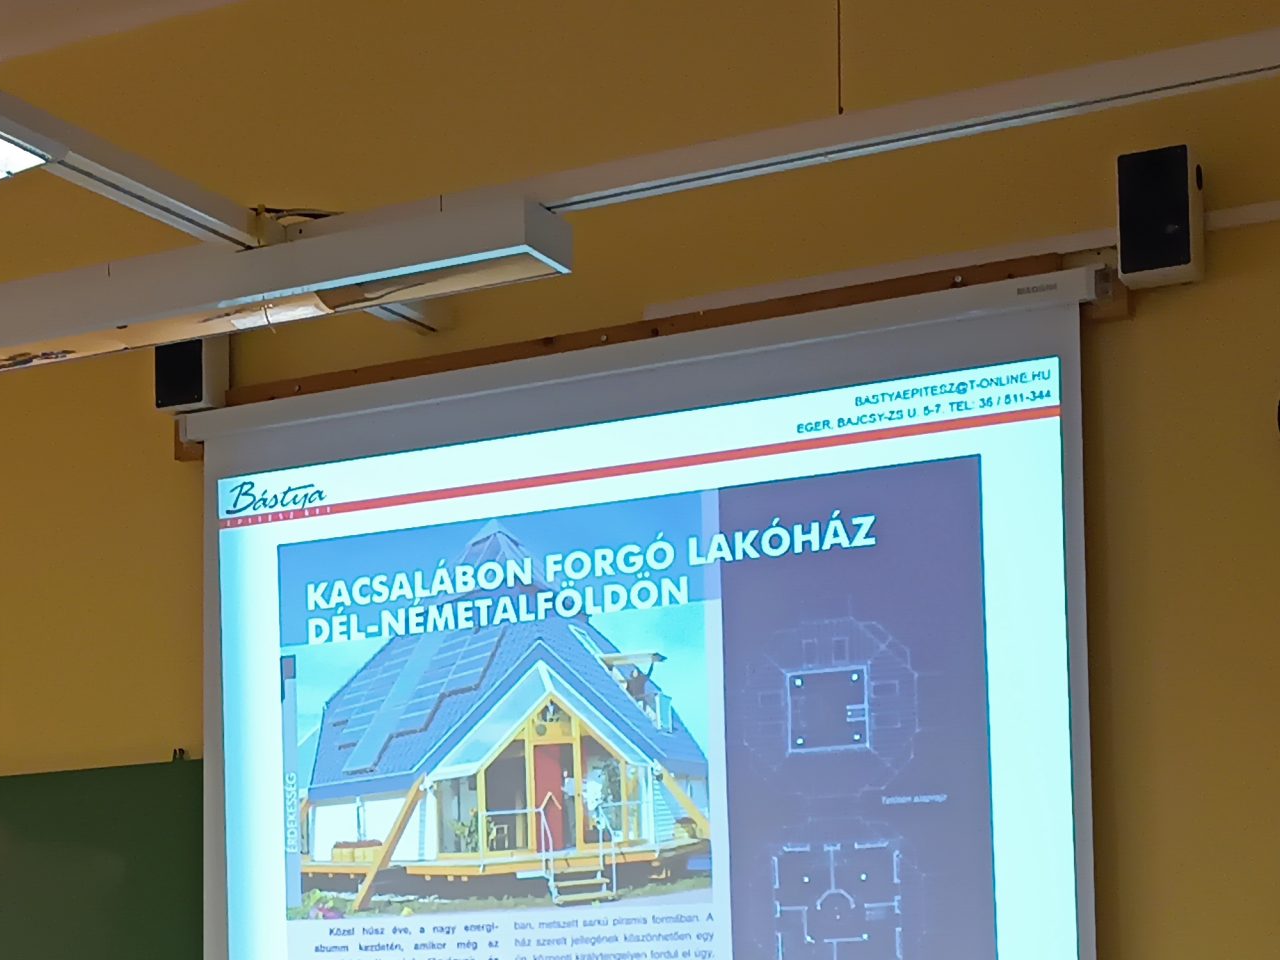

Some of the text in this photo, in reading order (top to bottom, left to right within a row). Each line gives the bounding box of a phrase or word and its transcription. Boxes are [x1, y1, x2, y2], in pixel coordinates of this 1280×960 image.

[979, 396, 994, 408] 36
[226, 481, 327, 515] Bástya
[306, 508, 877, 611] KACSALÁBON FORGÓ LAKÓHÁZ
[307, 571, 689, 644] DÉL-NÉMETALFÖLDÖN
[706, 913, 714, 921] A
[362, 926, 384, 935] húsz
[420, 926, 425, 934] a
[433, 925, 456, 936] nagy
[696, 932, 714, 942] egy
[414, 942, 446, 950] amikor
[457, 940, 477, 951] még
[488, 940, 499, 948] az
[651, 950, 678, 959] fordul
